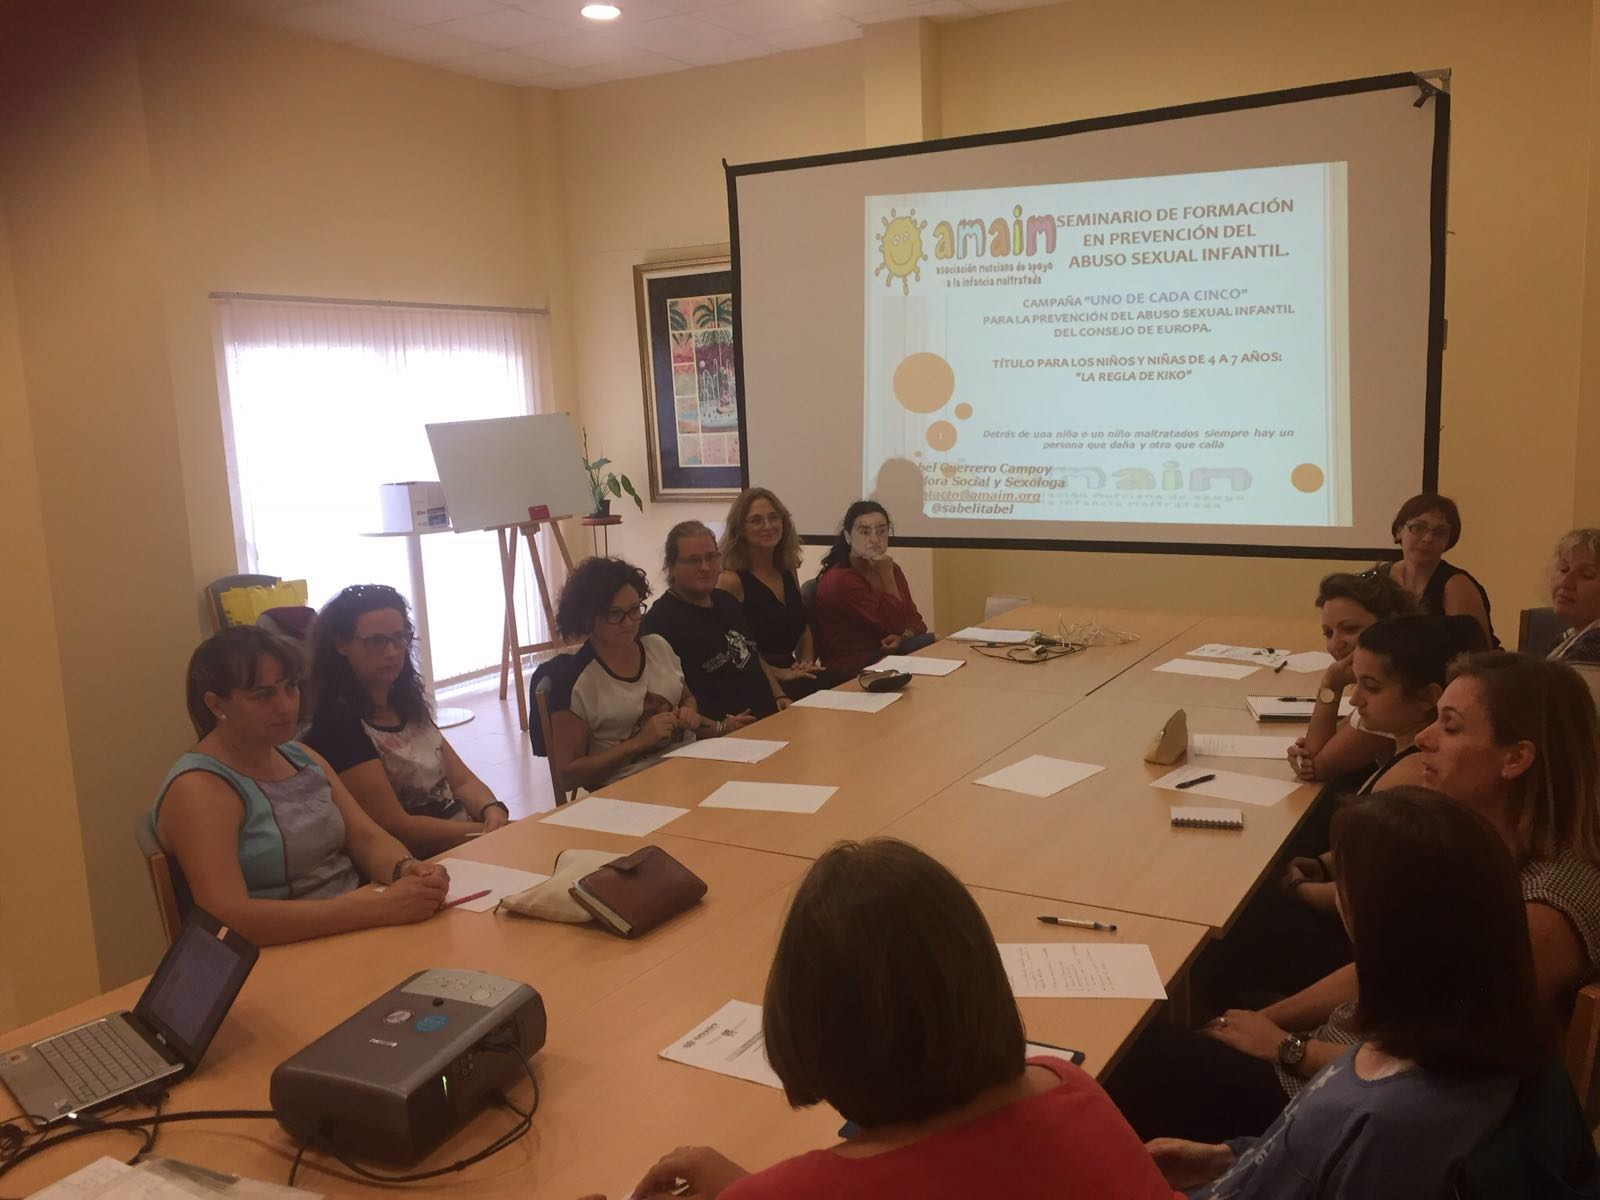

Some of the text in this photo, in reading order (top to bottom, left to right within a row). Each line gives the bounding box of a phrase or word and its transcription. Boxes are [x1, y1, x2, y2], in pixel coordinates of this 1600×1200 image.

[1056, 197, 1294, 228] SEMINARIO DE FORMACIÓN
[1083, 223, 1256, 247] EN PREVENCIÓN DEL
[1068, 243, 1290, 269] ABUSO SEXUAL INFANTIL.
[1016, 261, 1025, 272] de
[1027, 261, 1053, 274] apoyo
[962, 275, 994, 287] infancia
[1023, 295, 1082, 308] CAMPAÑA
[1126, 293, 1145, 304] DE
[1149, 291, 1190, 303] CADA
[983, 304, 1295, 326] PARA LA PREVENCIÓN DEL ABUSO SEXUAL INFANTIL
[1054, 323, 1212, 338] DEL CONSEJO DE EUROPA.
[992, 350, 1282, 369] TÍTULO PARA LOS NIÑOS Y NIÑAS DE 4 A 7 AÑOS:
[1098, 371, 1136, 381] REGLA
[1139, 370, 1154, 380] DE
[983, 429, 1015, 439] Detrás
[1018, 429, 1030, 439] de
[1033, 431, 1051, 439] una
[1056, 429, 1078, 439] niña
[1108, 429, 1131, 438] niño
[1134, 428, 1199, 438] maltratados
[1204, 428, 1249, 439] siempre
[1254, 428, 1275, 439] hay
[1279, 430, 1295, 438] un
[1043, 440, 1225, 450] persona que daña y otra que calla
[917, 462, 937, 474] bel
[1000, 463, 1053, 476] Campoy
[951, 476, 990, 488] Social
[994, 478, 1002, 488] y
[1005, 476, 1066, 489] Sexóloga
[932, 503, 1014, 515] @sabelitabel
